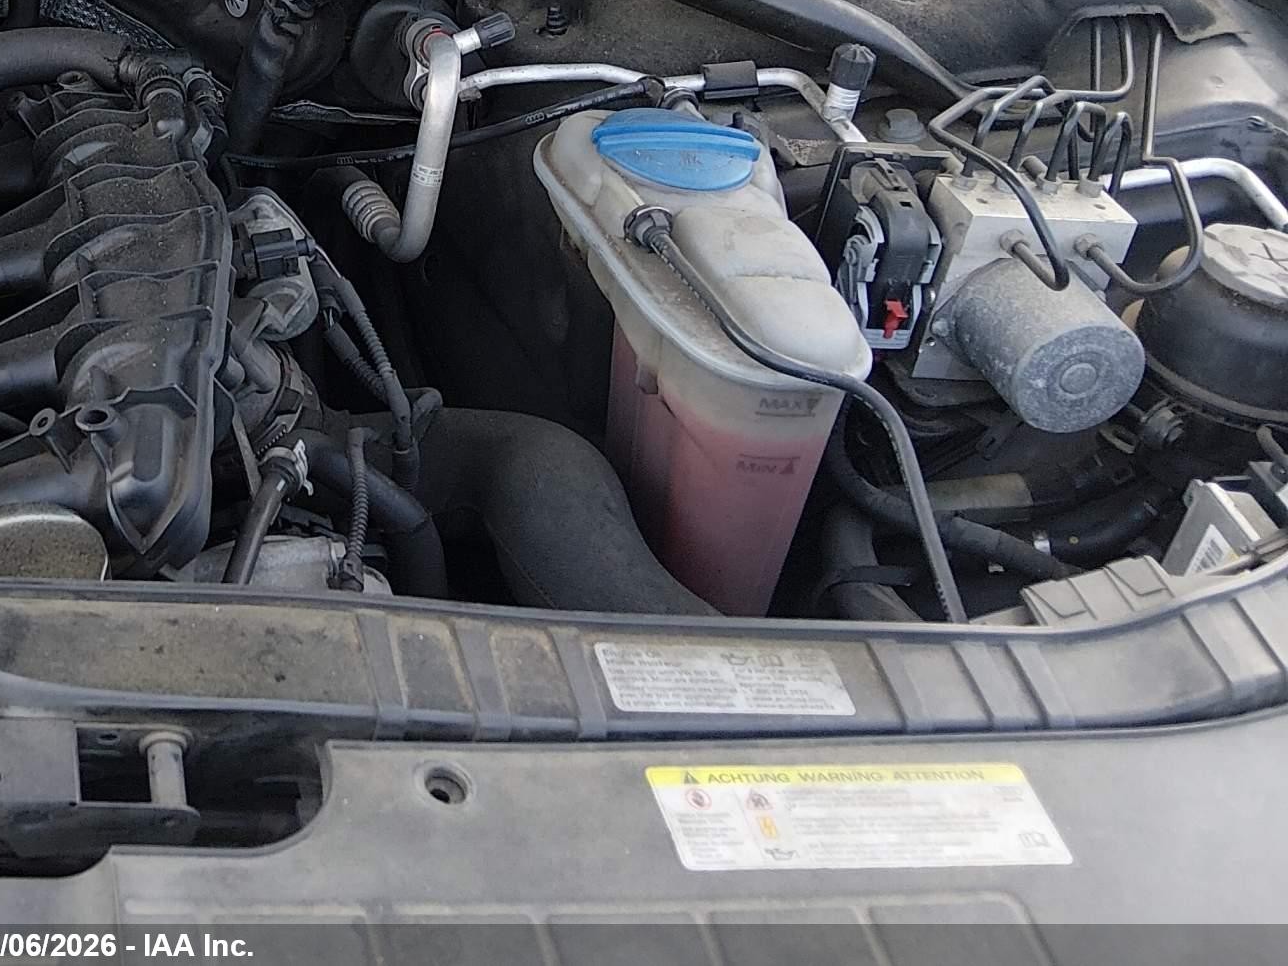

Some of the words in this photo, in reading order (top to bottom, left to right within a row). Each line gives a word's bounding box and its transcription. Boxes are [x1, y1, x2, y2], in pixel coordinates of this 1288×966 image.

[759, 397, 801, 410] MAX
[707, 772, 791, 784] ACHTUNG
[799, 771, 884, 783] WARNING
[892, 769, 985, 782] ATTENTION
